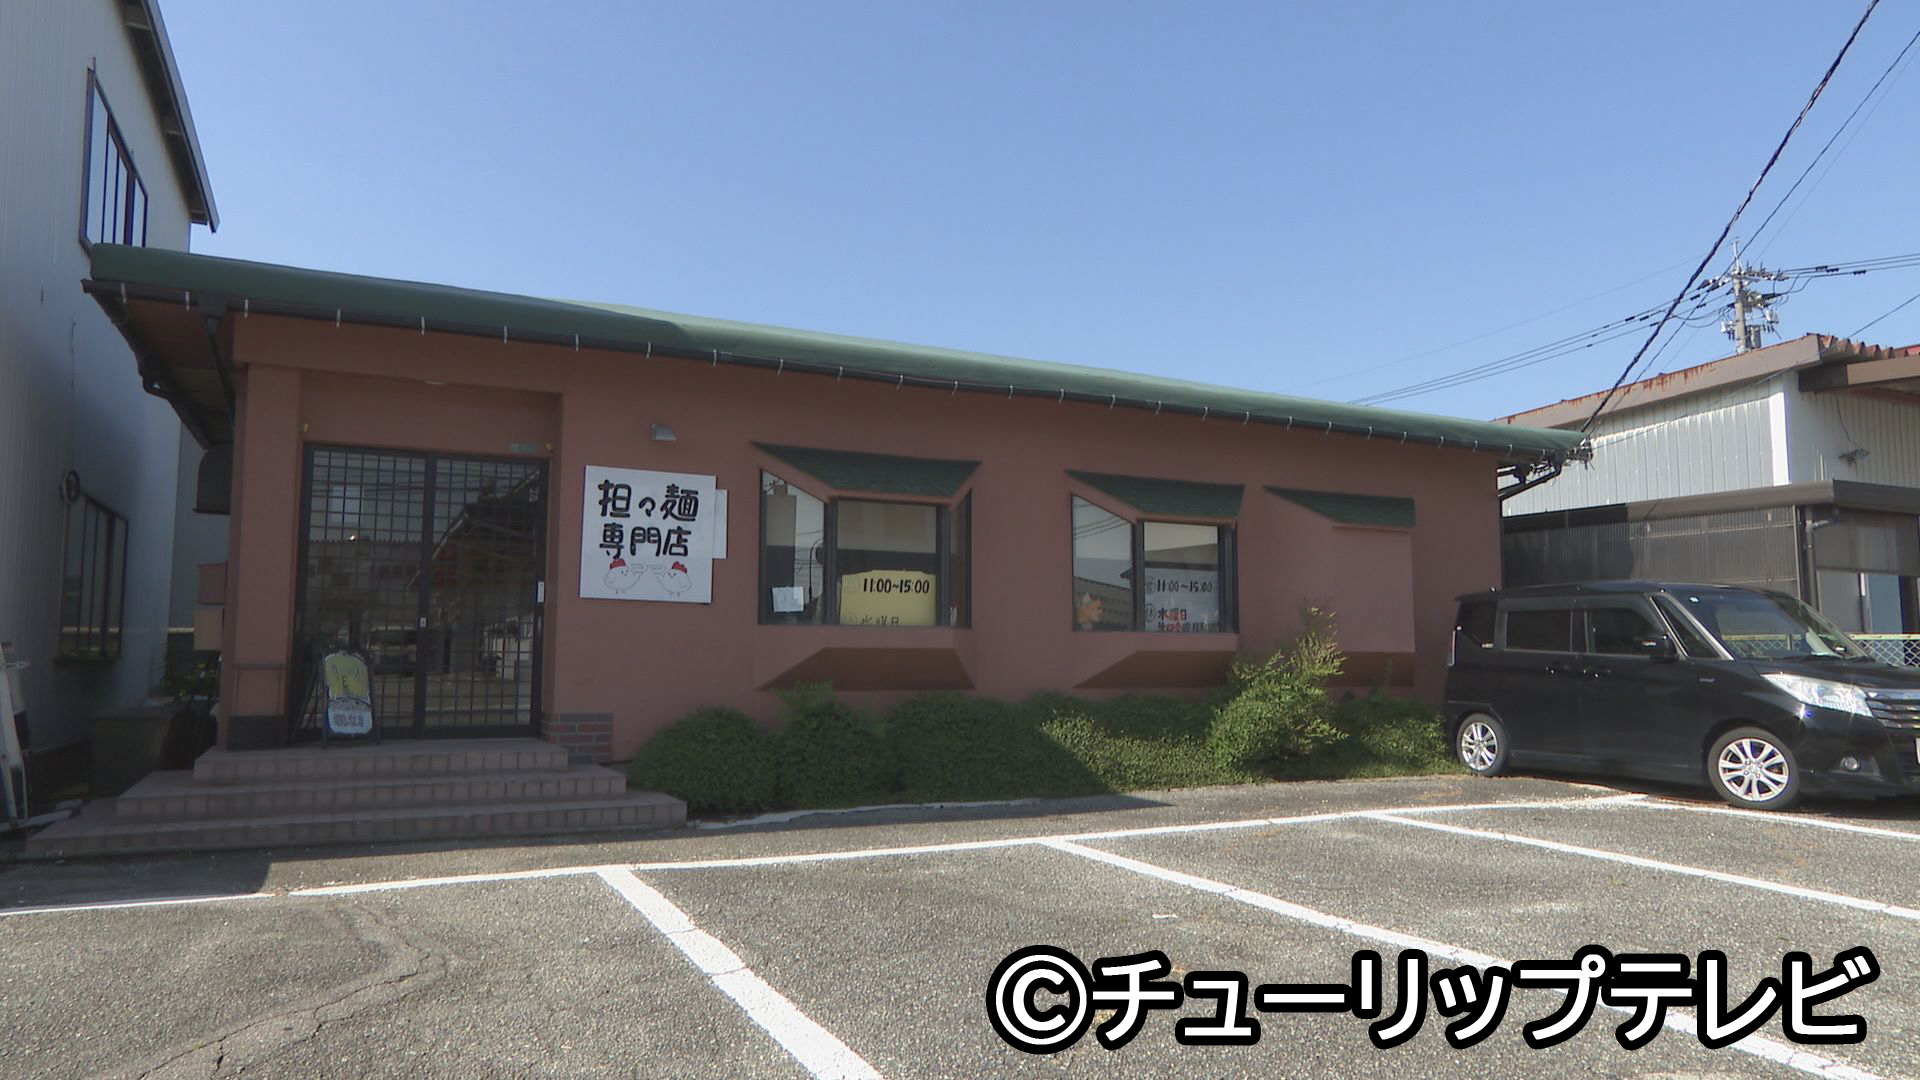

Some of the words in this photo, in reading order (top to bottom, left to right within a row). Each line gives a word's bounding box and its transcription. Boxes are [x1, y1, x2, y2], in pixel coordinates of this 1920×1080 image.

[598, 479, 699, 522] 担々麺
[599, 522, 692, 559] 専門店
